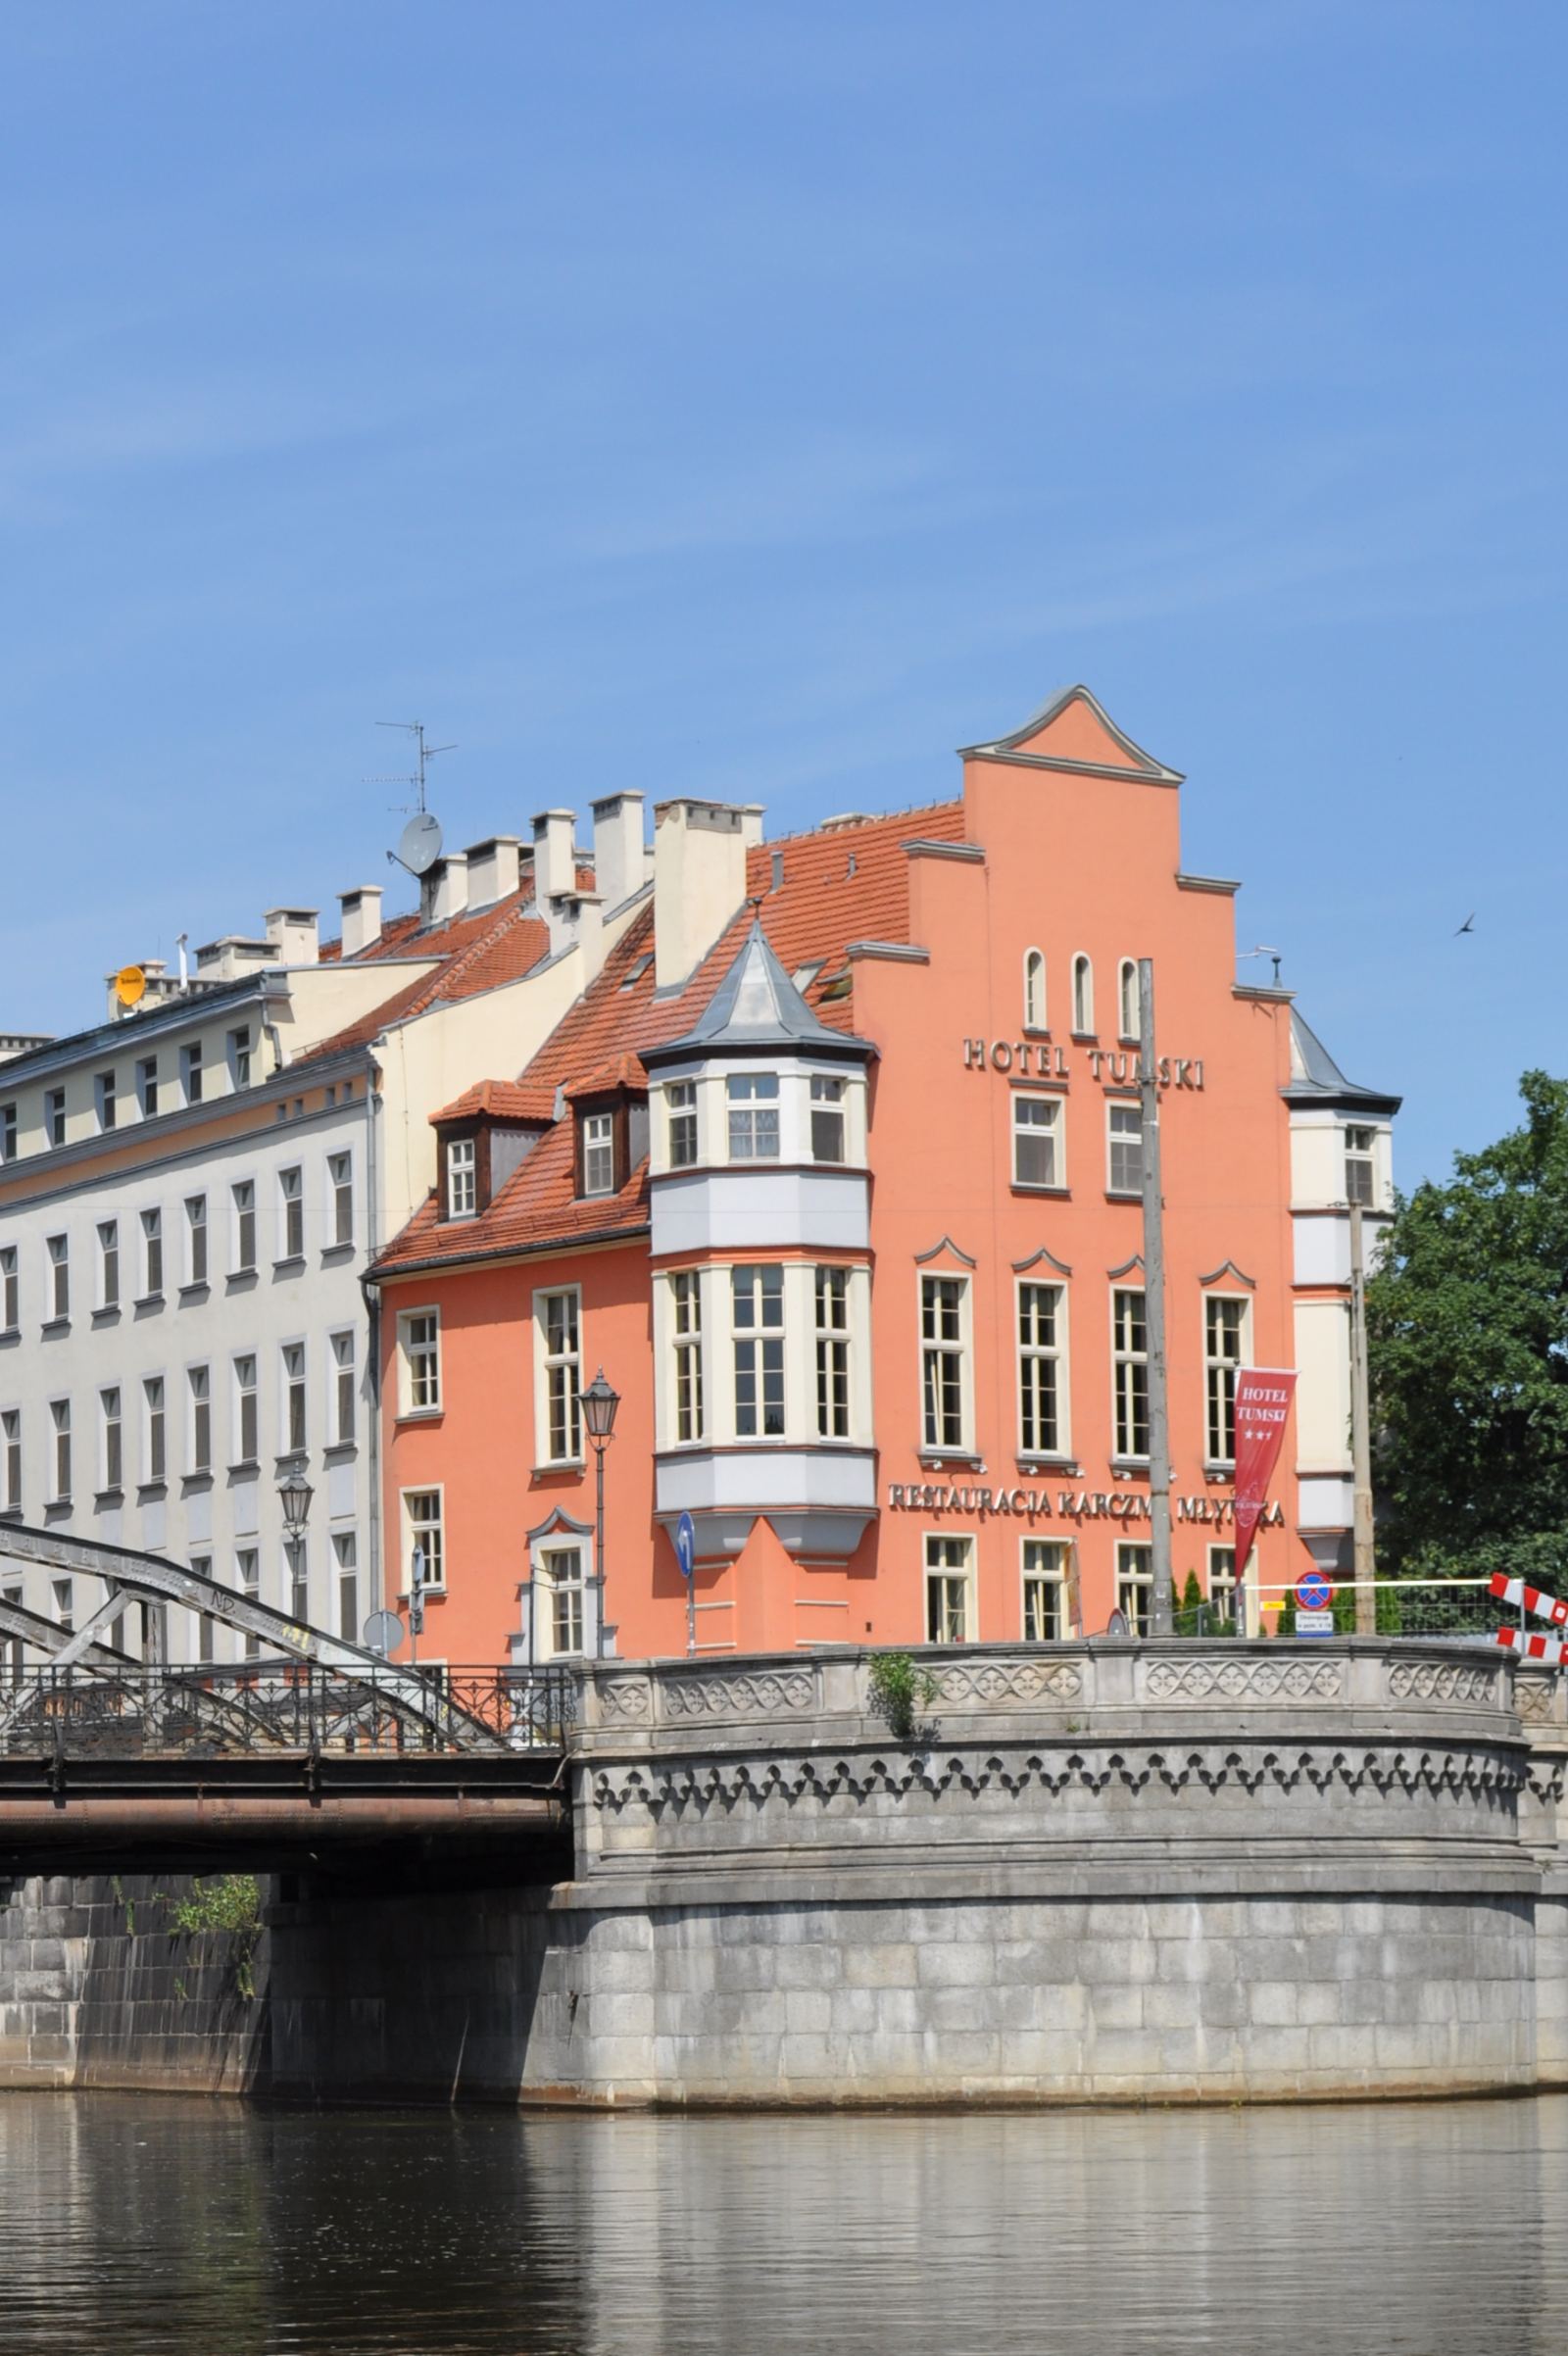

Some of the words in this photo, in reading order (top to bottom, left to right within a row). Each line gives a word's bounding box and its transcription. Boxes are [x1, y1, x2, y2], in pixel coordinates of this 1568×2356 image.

[963, 1039, 1069, 1074] HOTEL
[1243, 1387, 1288, 1402] HOTEL
[1236, 1406, 1286, 1422] TUMSKI
[889, 1484, 1052, 1513] RESTAURACJA
[1058, 1492, 1153, 1518] KARCZM
